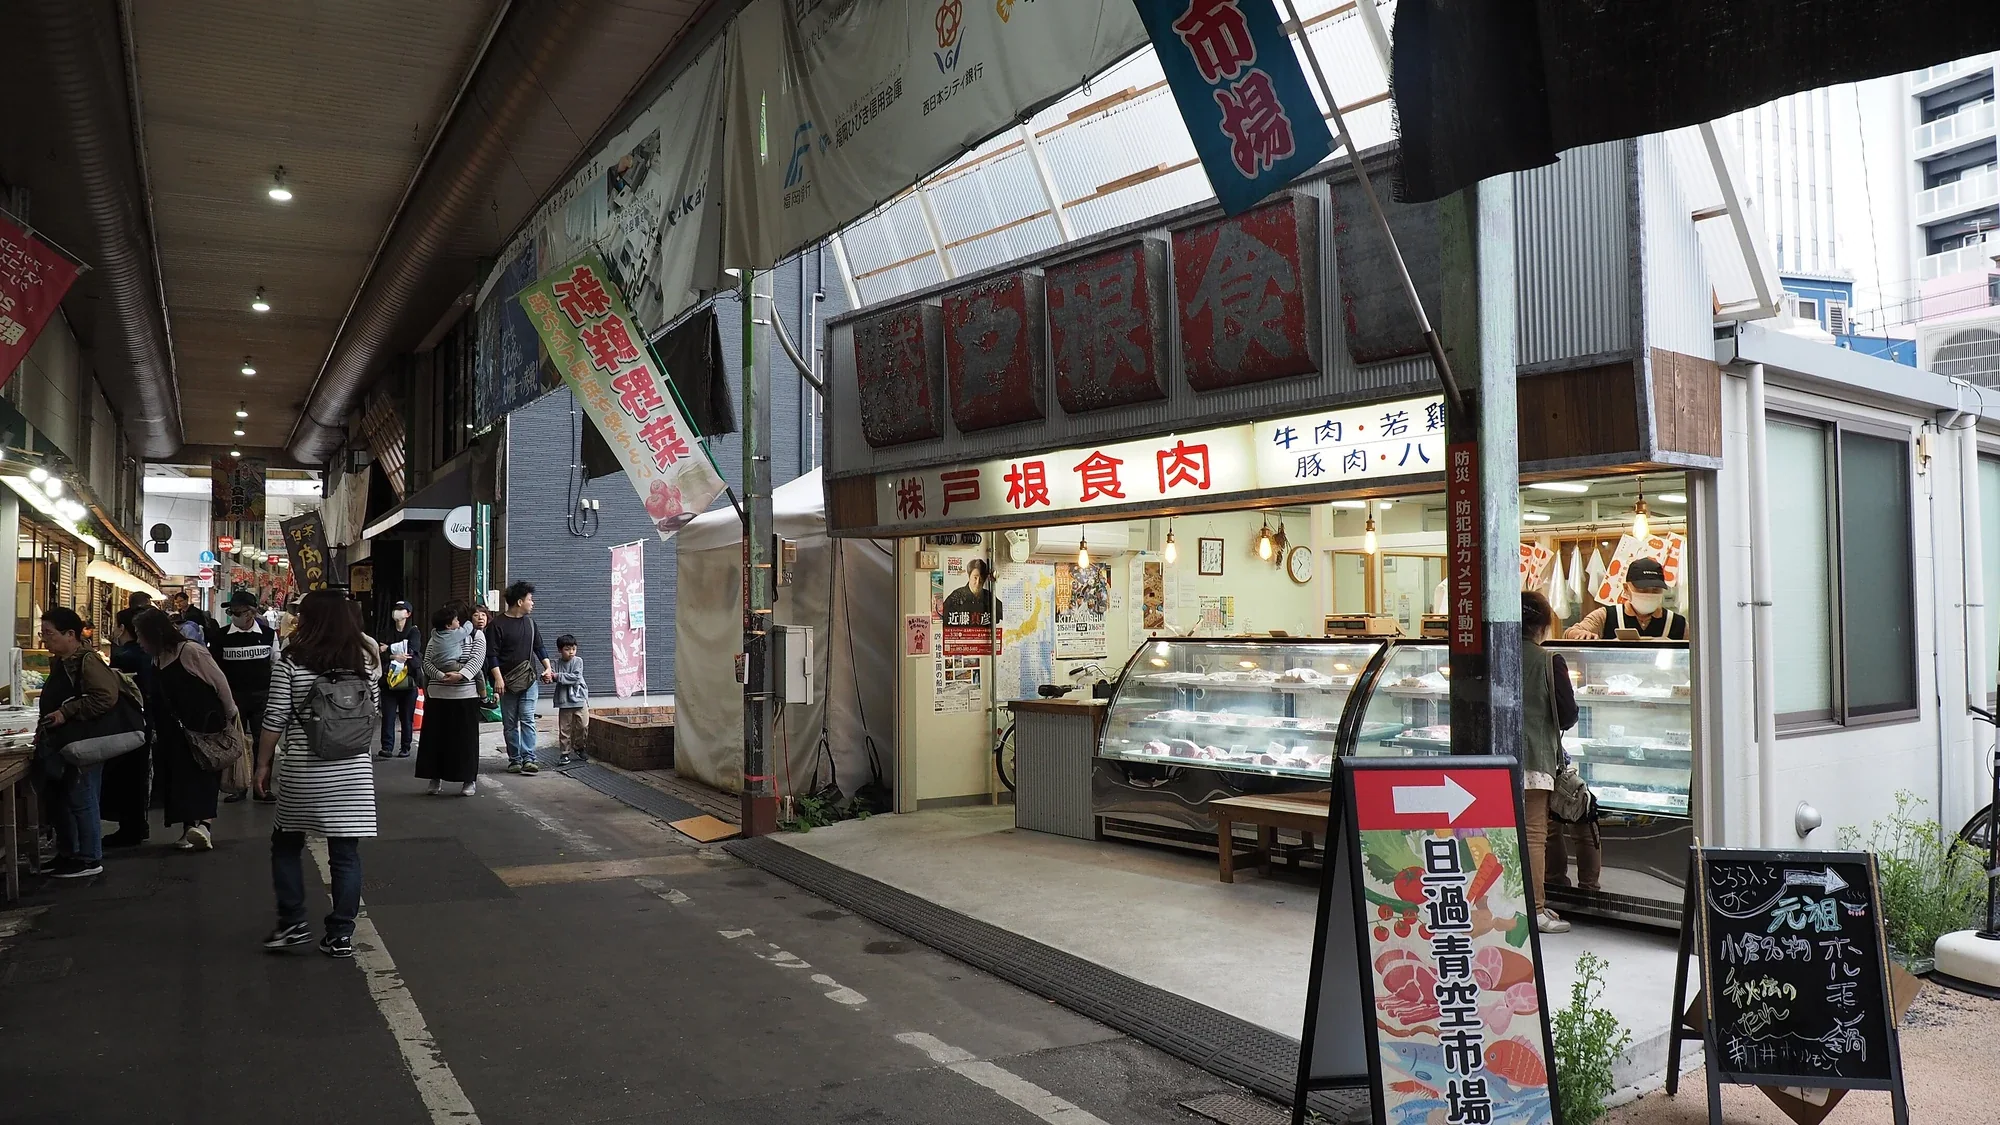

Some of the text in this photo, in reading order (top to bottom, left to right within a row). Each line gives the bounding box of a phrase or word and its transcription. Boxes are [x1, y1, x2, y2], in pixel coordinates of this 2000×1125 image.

[835, 77, 903, 149] 福岡ひびき信用金庫
[922, 62, 984, 117] 西日本シティ銀行
[1172, 0, 1297, 180] 市場
[1454, 450, 1475, 647] 防災・防犯用カメラ作動中
[947, 611, 991, 626] 近藤真彦
[935, 643, 943, 695] 地球一周の船旅
[1719, 889, 1757, 911] すぐ
[1766, 896, 1843, 933] 元祖
[1720, 932, 1812, 965] 小倉名物
[1421, 838, 1492, 1125] 旦過青空市場
[1738, 1002, 1790, 1036] たれ
